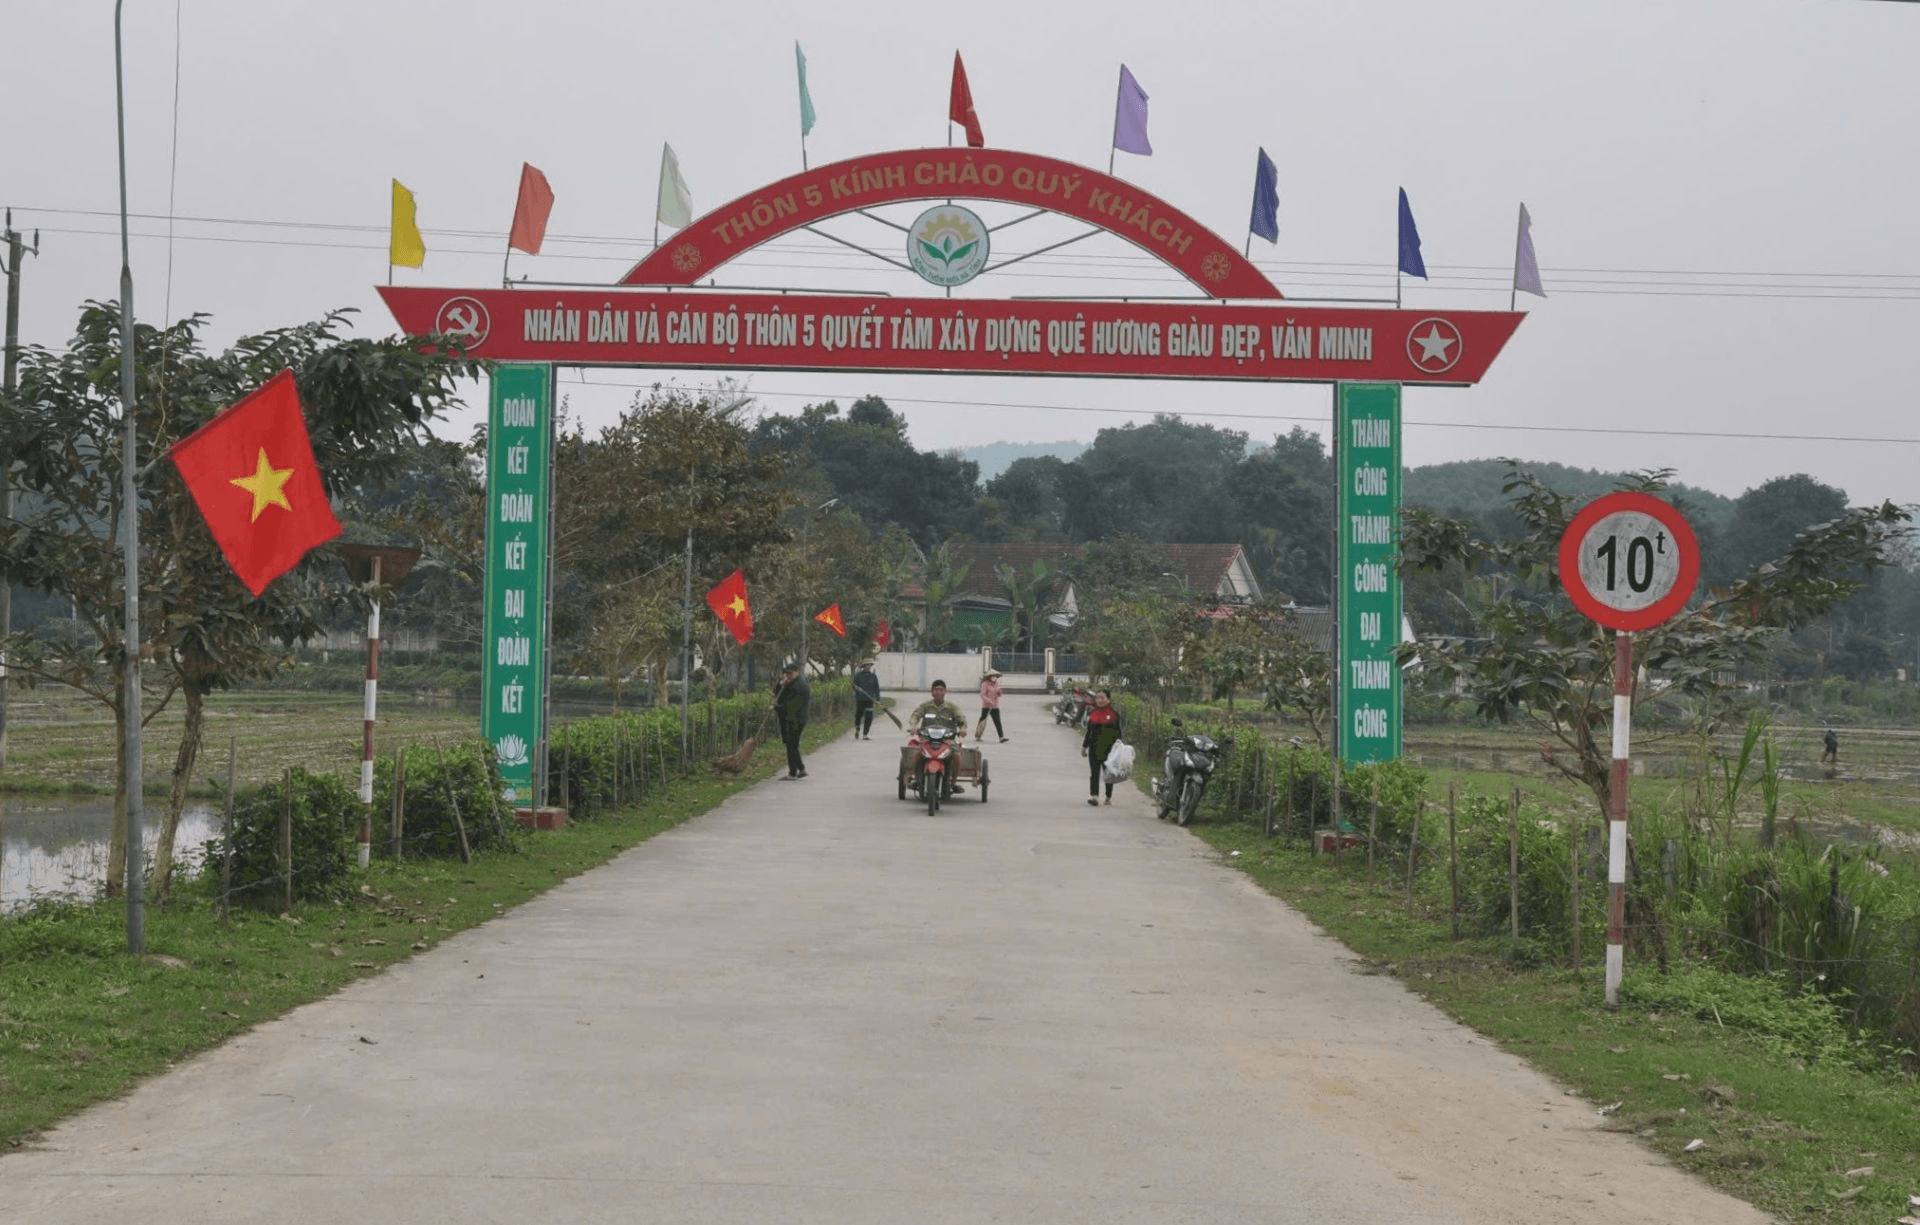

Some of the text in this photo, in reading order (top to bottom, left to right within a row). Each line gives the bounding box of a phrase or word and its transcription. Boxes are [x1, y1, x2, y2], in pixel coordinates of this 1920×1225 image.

[712, 155, 1193, 255] THÔN 5 KÍNH CHÀO QUÝ KHÁCH
[524, 301, 1373, 365] NHÂN DÂN VÀ CÁN BỘ THÔN 5 QUYẾT TÂM XÂY DỰNG QUÊ HƯƠNG GIÀU ĐẸP, VĂN MINH
[503, 393, 535, 427] ĐOÀN
[1351, 412, 1390, 448] THÀNH
[507, 436, 529, 474] KẾT
[1354, 461, 1387, 496] CÔNG
[501, 488, 533, 522] ĐOÀN
[1351, 509, 1390, 544] THÀNH
[505, 532, 527, 570] KẾT
[1354, 557, 1387, 592] CÔNG
[505, 589, 525, 624] ĐẠI
[1360, 612, 1381, 648] ĐẠI
[498, 631, 529, 666] ĐOÀN
[1351, 654, 1390, 689] THÀNH
[502, 674, 524, 713] KẾT
[1354, 702, 1387, 738] CÔNG
